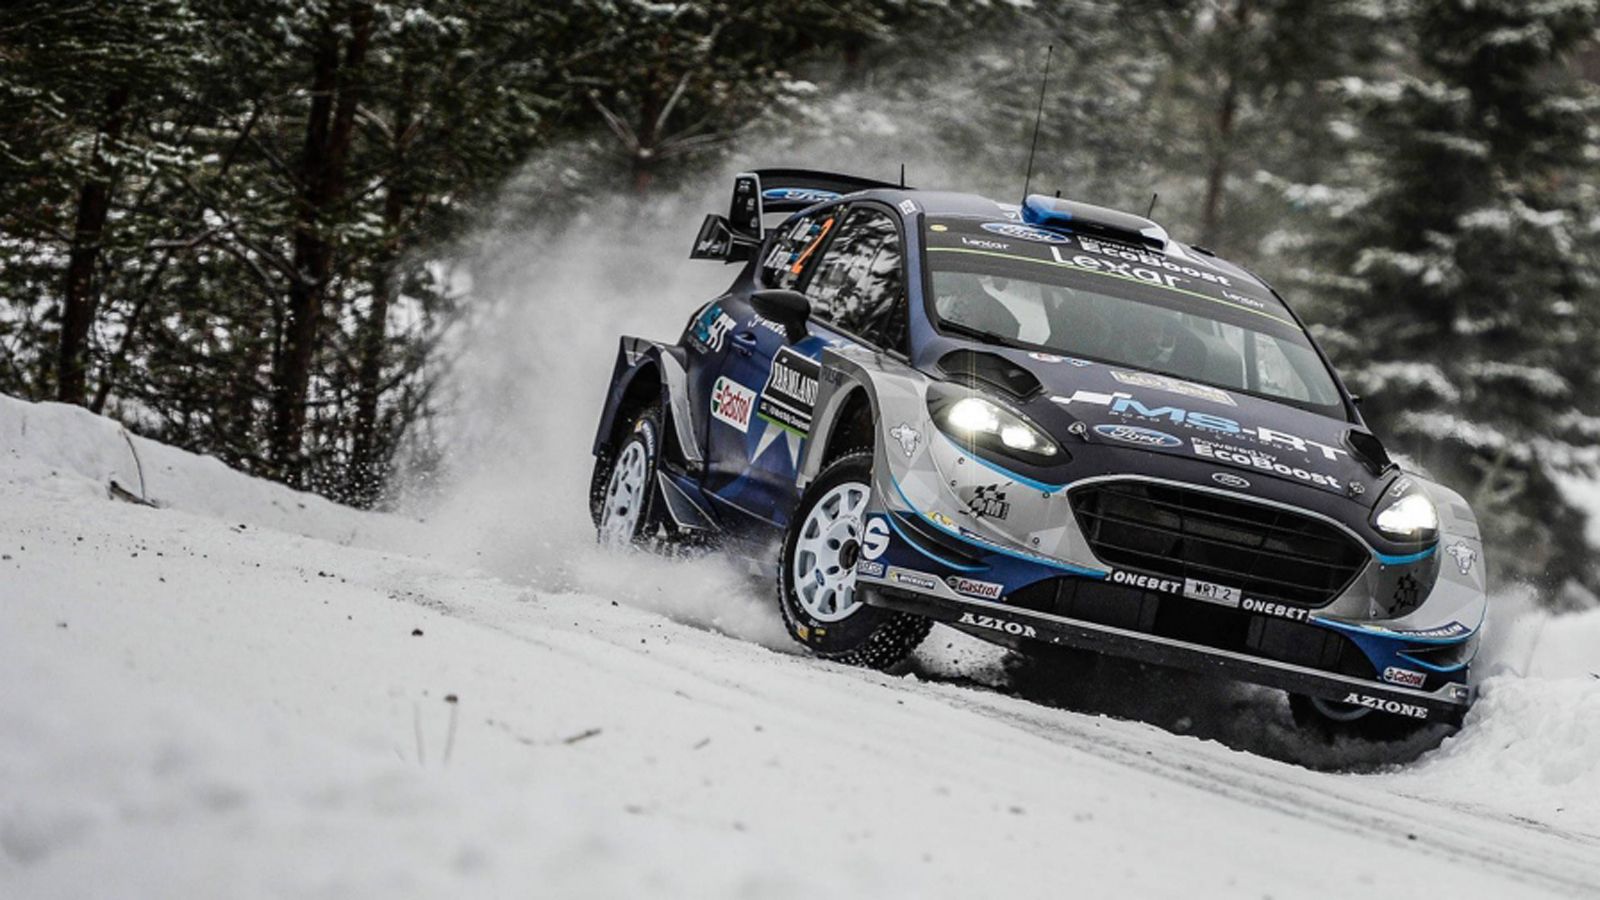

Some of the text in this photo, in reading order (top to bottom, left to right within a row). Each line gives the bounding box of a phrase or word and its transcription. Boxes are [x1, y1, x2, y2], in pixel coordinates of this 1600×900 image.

[961, 236, 1011, 250] Lexar
[1050, 245, 1182, 288] Lexar
[1080, 240, 1232, 287] EcoBoost
[719, 384, 753, 426] Castrol
[1190, 437, 1256, 458] Powered
[1193, 443, 1342, 489] EcoBoost
[958, 580, 999, 598] Castrol
[1113, 570, 1182, 594] ONEBET
[1222, 588, 1232, 600] 2
[1241, 598, 1310, 621] ONEBET
[1393, 671, 1423, 686] Castrol
[1342, 692, 1429, 719] AZIONE
